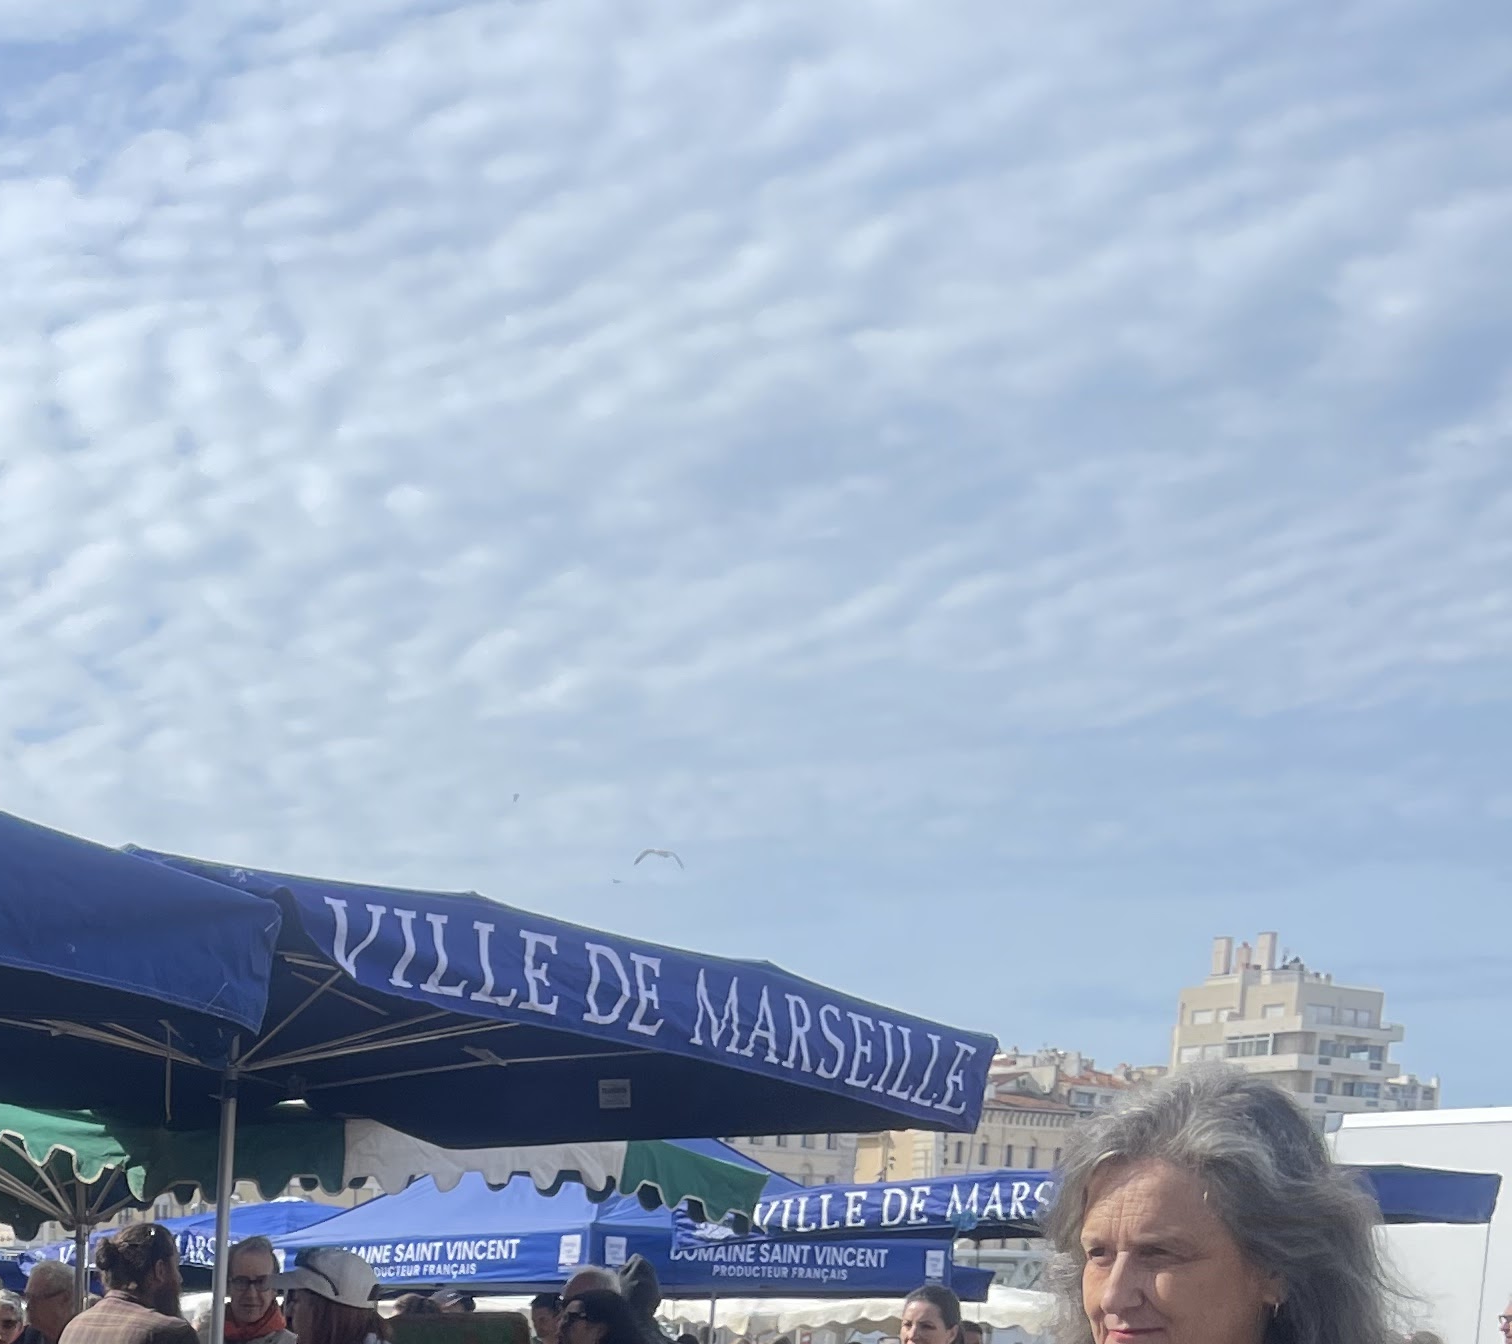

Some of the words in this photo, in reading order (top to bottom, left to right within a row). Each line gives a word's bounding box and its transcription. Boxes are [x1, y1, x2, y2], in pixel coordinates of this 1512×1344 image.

[323, 895, 559, 1017] VILLE
[582, 940, 665, 1037] DE
[689, 966, 978, 1116] MARSEILLE
[752, 1191, 868, 1234] VILLE
[880, 1184, 932, 1227] DE
[394, 1242, 443, 1263] SAINT
[446, 1239, 520, 1261] VINCENT
[759, 1244, 811, 1265] SAINT
[814, 1246, 889, 1268] VINCENT
[373, 1264, 420, 1277] DUCTEUR
[422, 1263, 477, 1279] FRANÇAIS
[711, 1264, 789, 1279] PRODUCTEUR
[791, 1267, 848, 1283] FRANÇAIS
